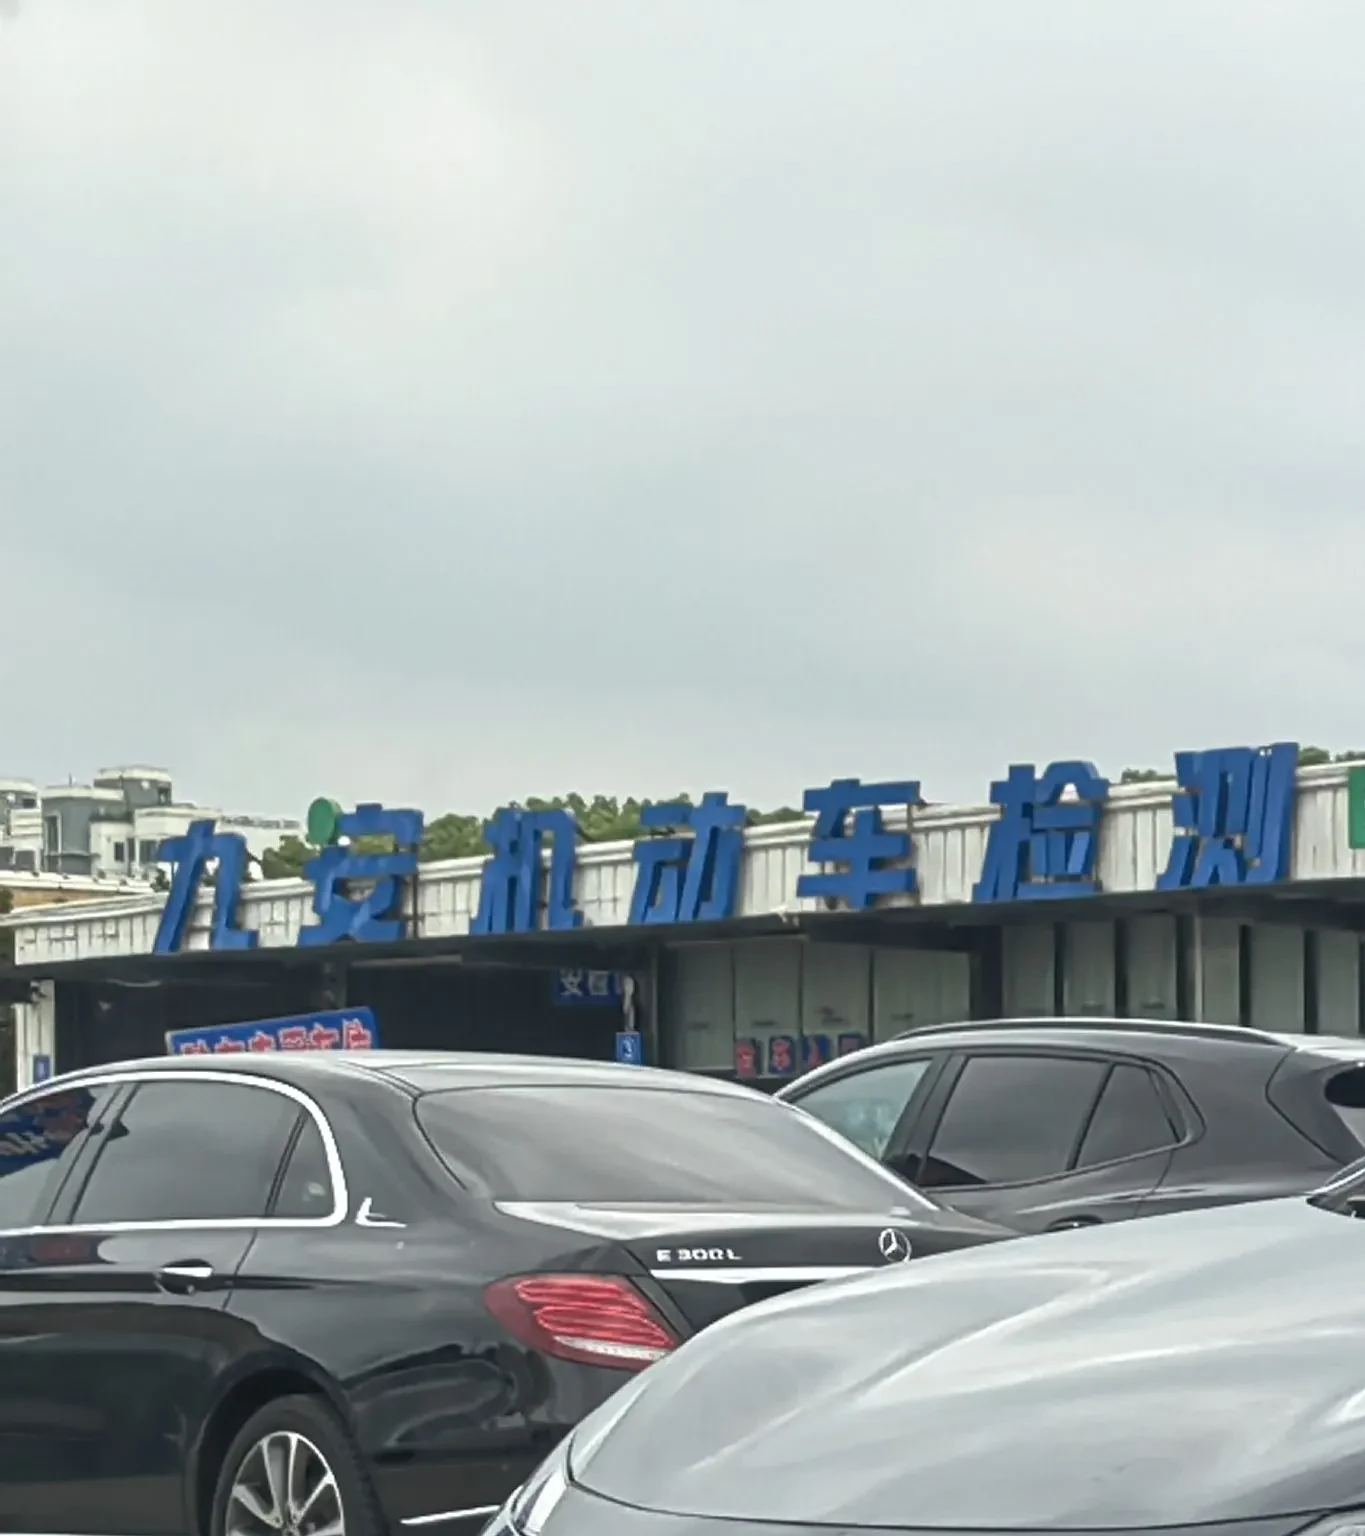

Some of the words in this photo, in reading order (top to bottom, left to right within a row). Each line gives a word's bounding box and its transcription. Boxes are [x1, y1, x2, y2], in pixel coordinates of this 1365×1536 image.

[154, 742, 1299, 955] 九安机动车检测
